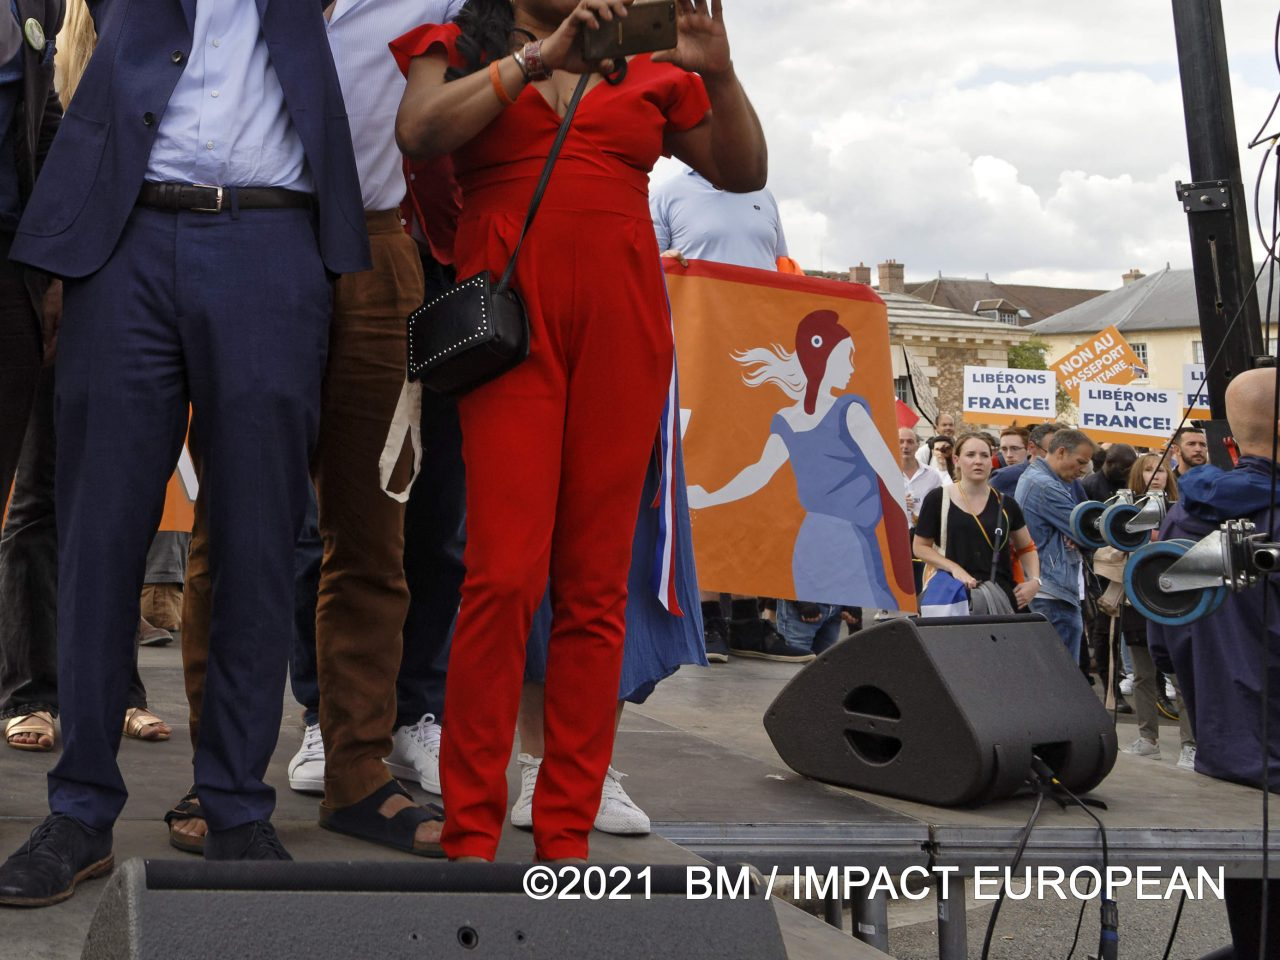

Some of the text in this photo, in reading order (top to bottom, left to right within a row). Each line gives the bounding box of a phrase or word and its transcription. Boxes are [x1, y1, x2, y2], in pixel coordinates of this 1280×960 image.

[1058, 333, 1115, 376] NON AU
[1064, 345, 1126, 390] PASSEPORT
[972, 370, 1046, 384] LIBÉRONS
[997, 384, 1017, 394] LA
[1088, 388, 1168, 403] LIBÉRONS
[968, 396, 1050, 411] FRANCE!
[1115, 401, 1136, 412] LA
[1083, 413, 1171, 431] FRANCE!
